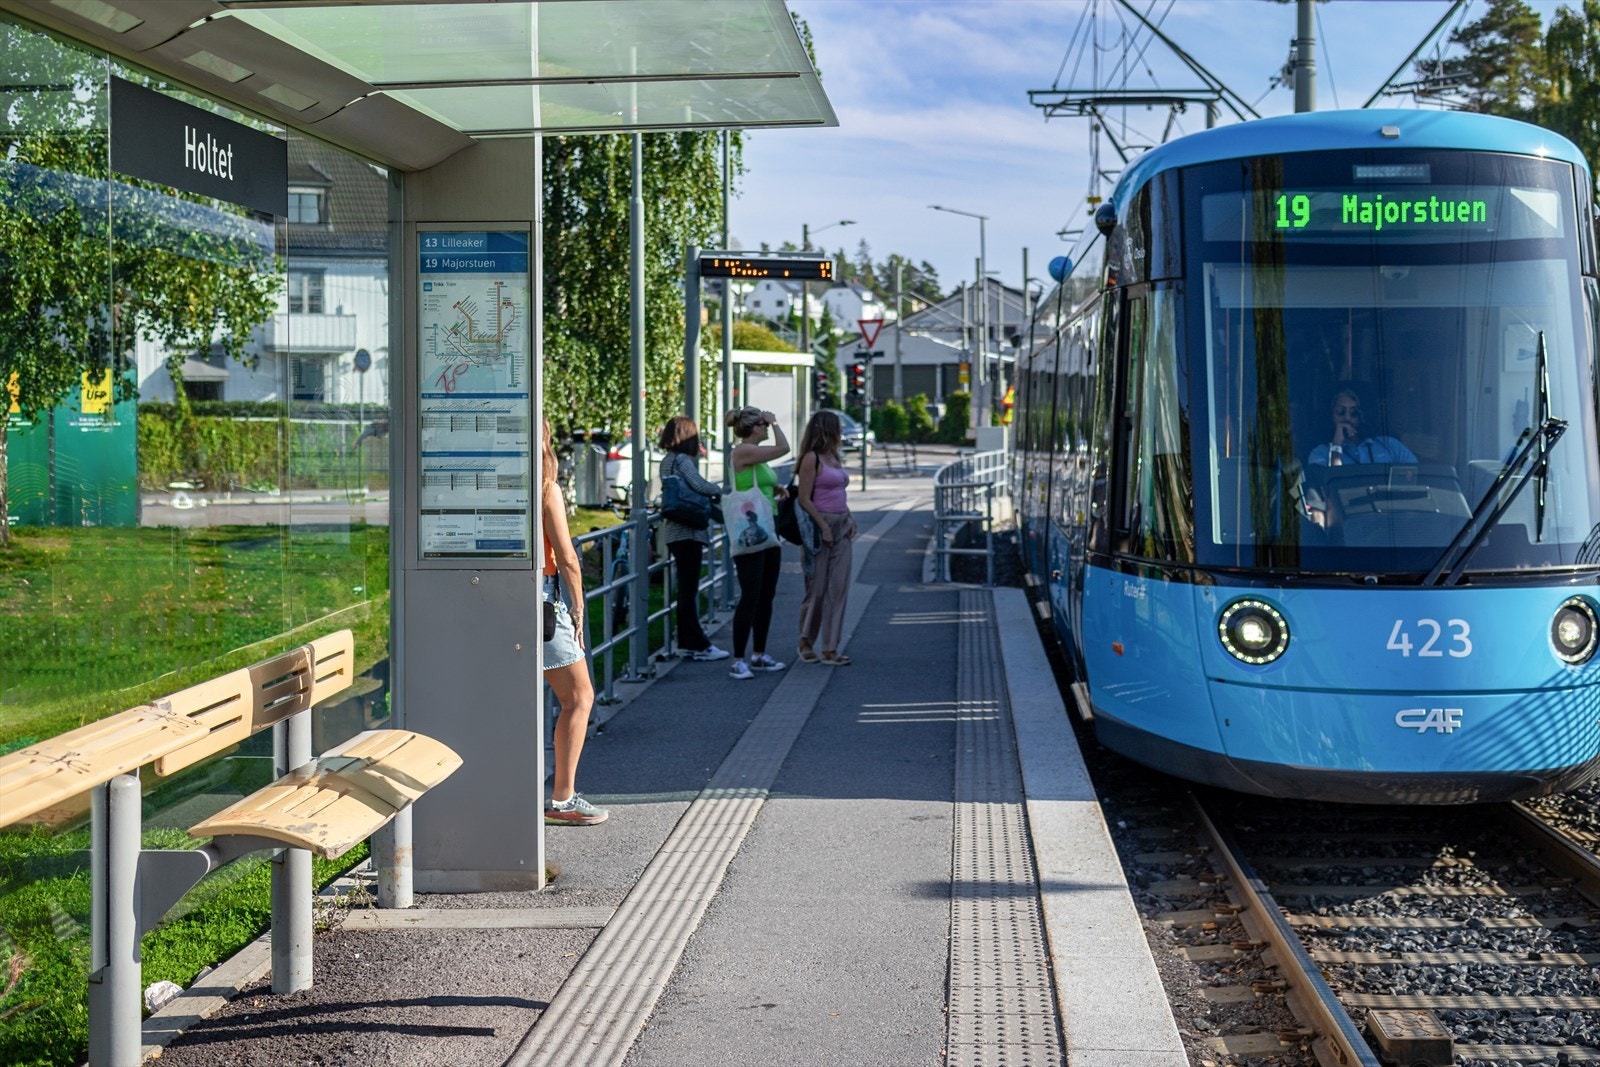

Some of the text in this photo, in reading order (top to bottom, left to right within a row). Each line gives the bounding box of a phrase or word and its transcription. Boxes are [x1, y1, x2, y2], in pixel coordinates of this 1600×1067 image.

[185, 125, 233, 181] Holtet
[1276, 194, 1486, 230] 19 Majorstuen
[425, 238, 484, 248] 13 Lilleaker
[425, 258, 496, 270] 19 Majorstuen
[1386, 618, 1473, 658] 423
[1395, 708, 1463, 734] CAF
